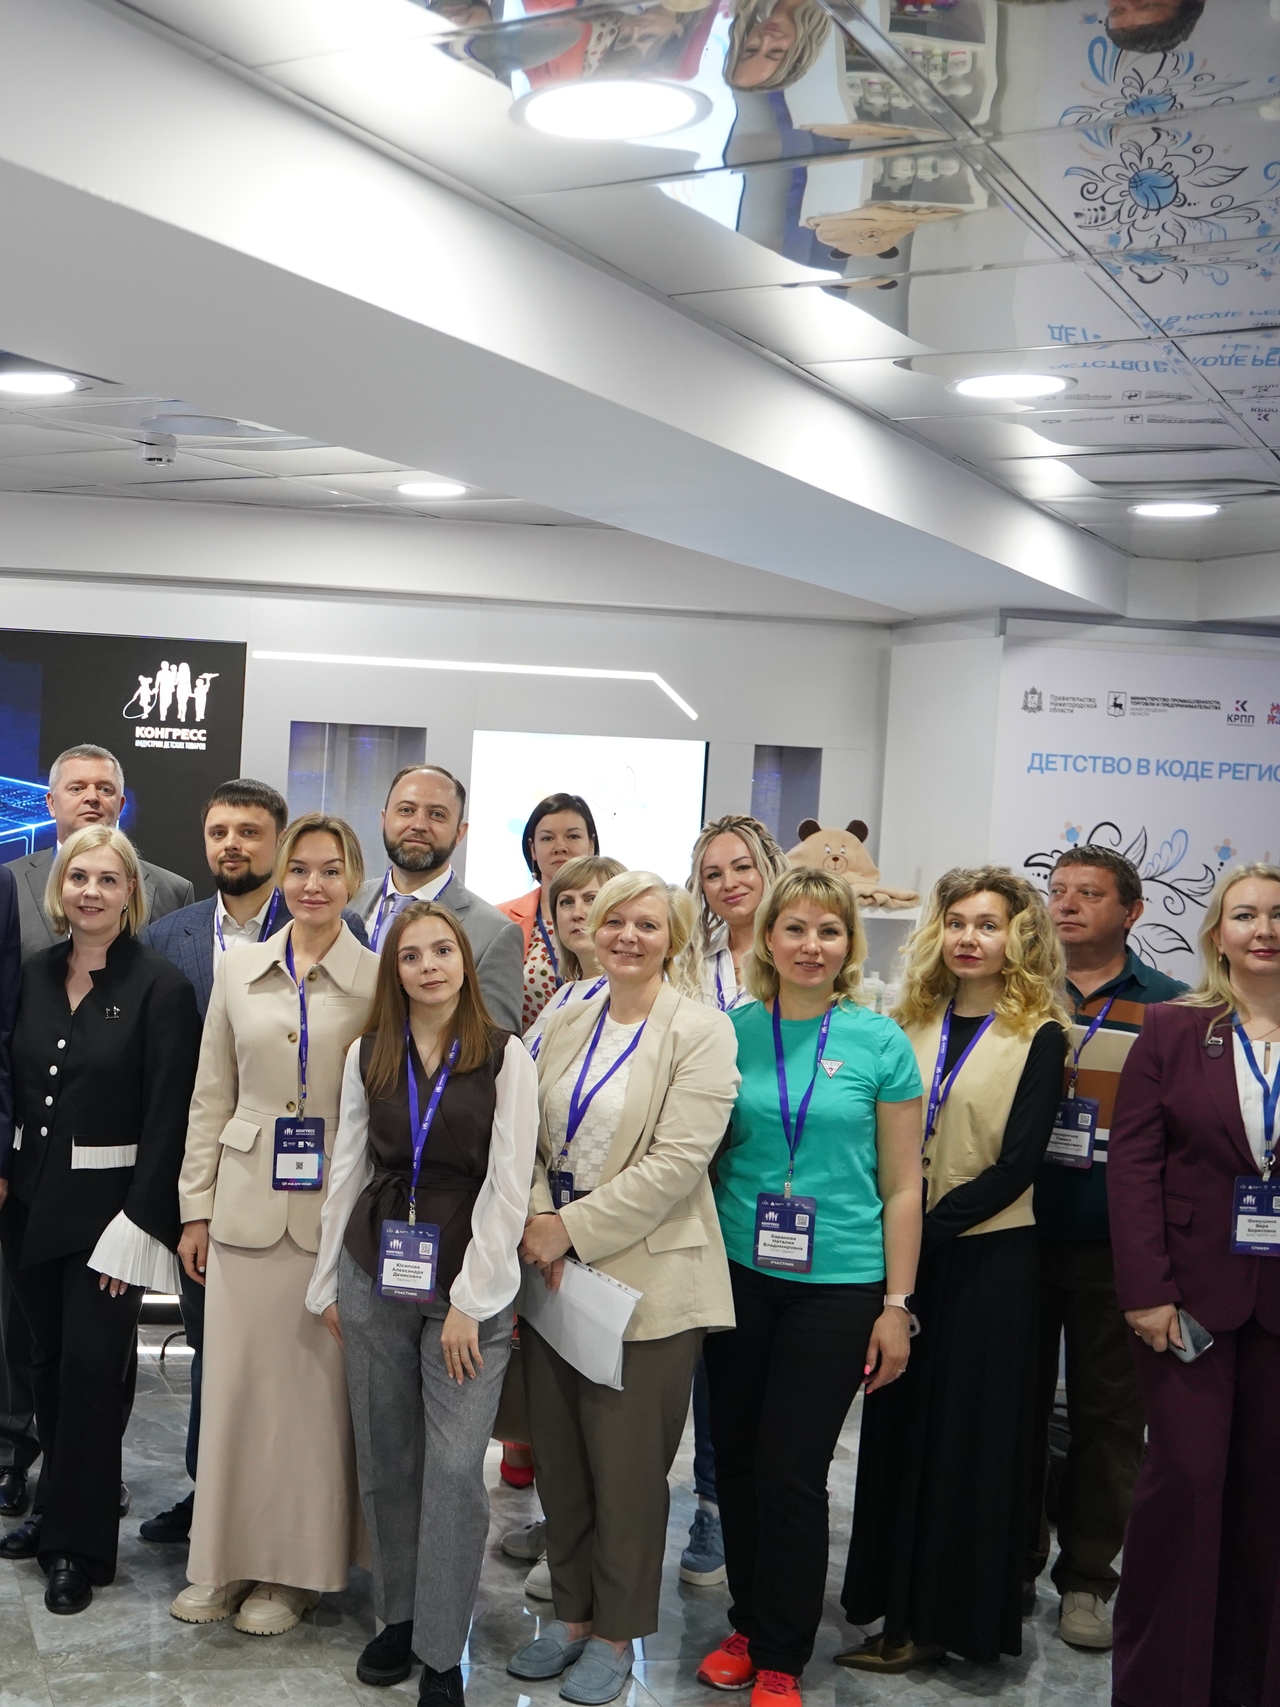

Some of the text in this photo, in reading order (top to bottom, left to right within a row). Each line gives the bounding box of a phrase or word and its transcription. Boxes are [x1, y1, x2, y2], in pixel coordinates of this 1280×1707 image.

[1227, 714, 1255, 724] КРПП
[135, 726, 207, 741] КОНГРЕСС
[1027, 753, 1132, 775] ДЕТСТВО
[1137, 758, 1151, 776] В
[1155, 759, 1214, 782] КОДЕ
[392, 1267, 424, 1275] Александра
